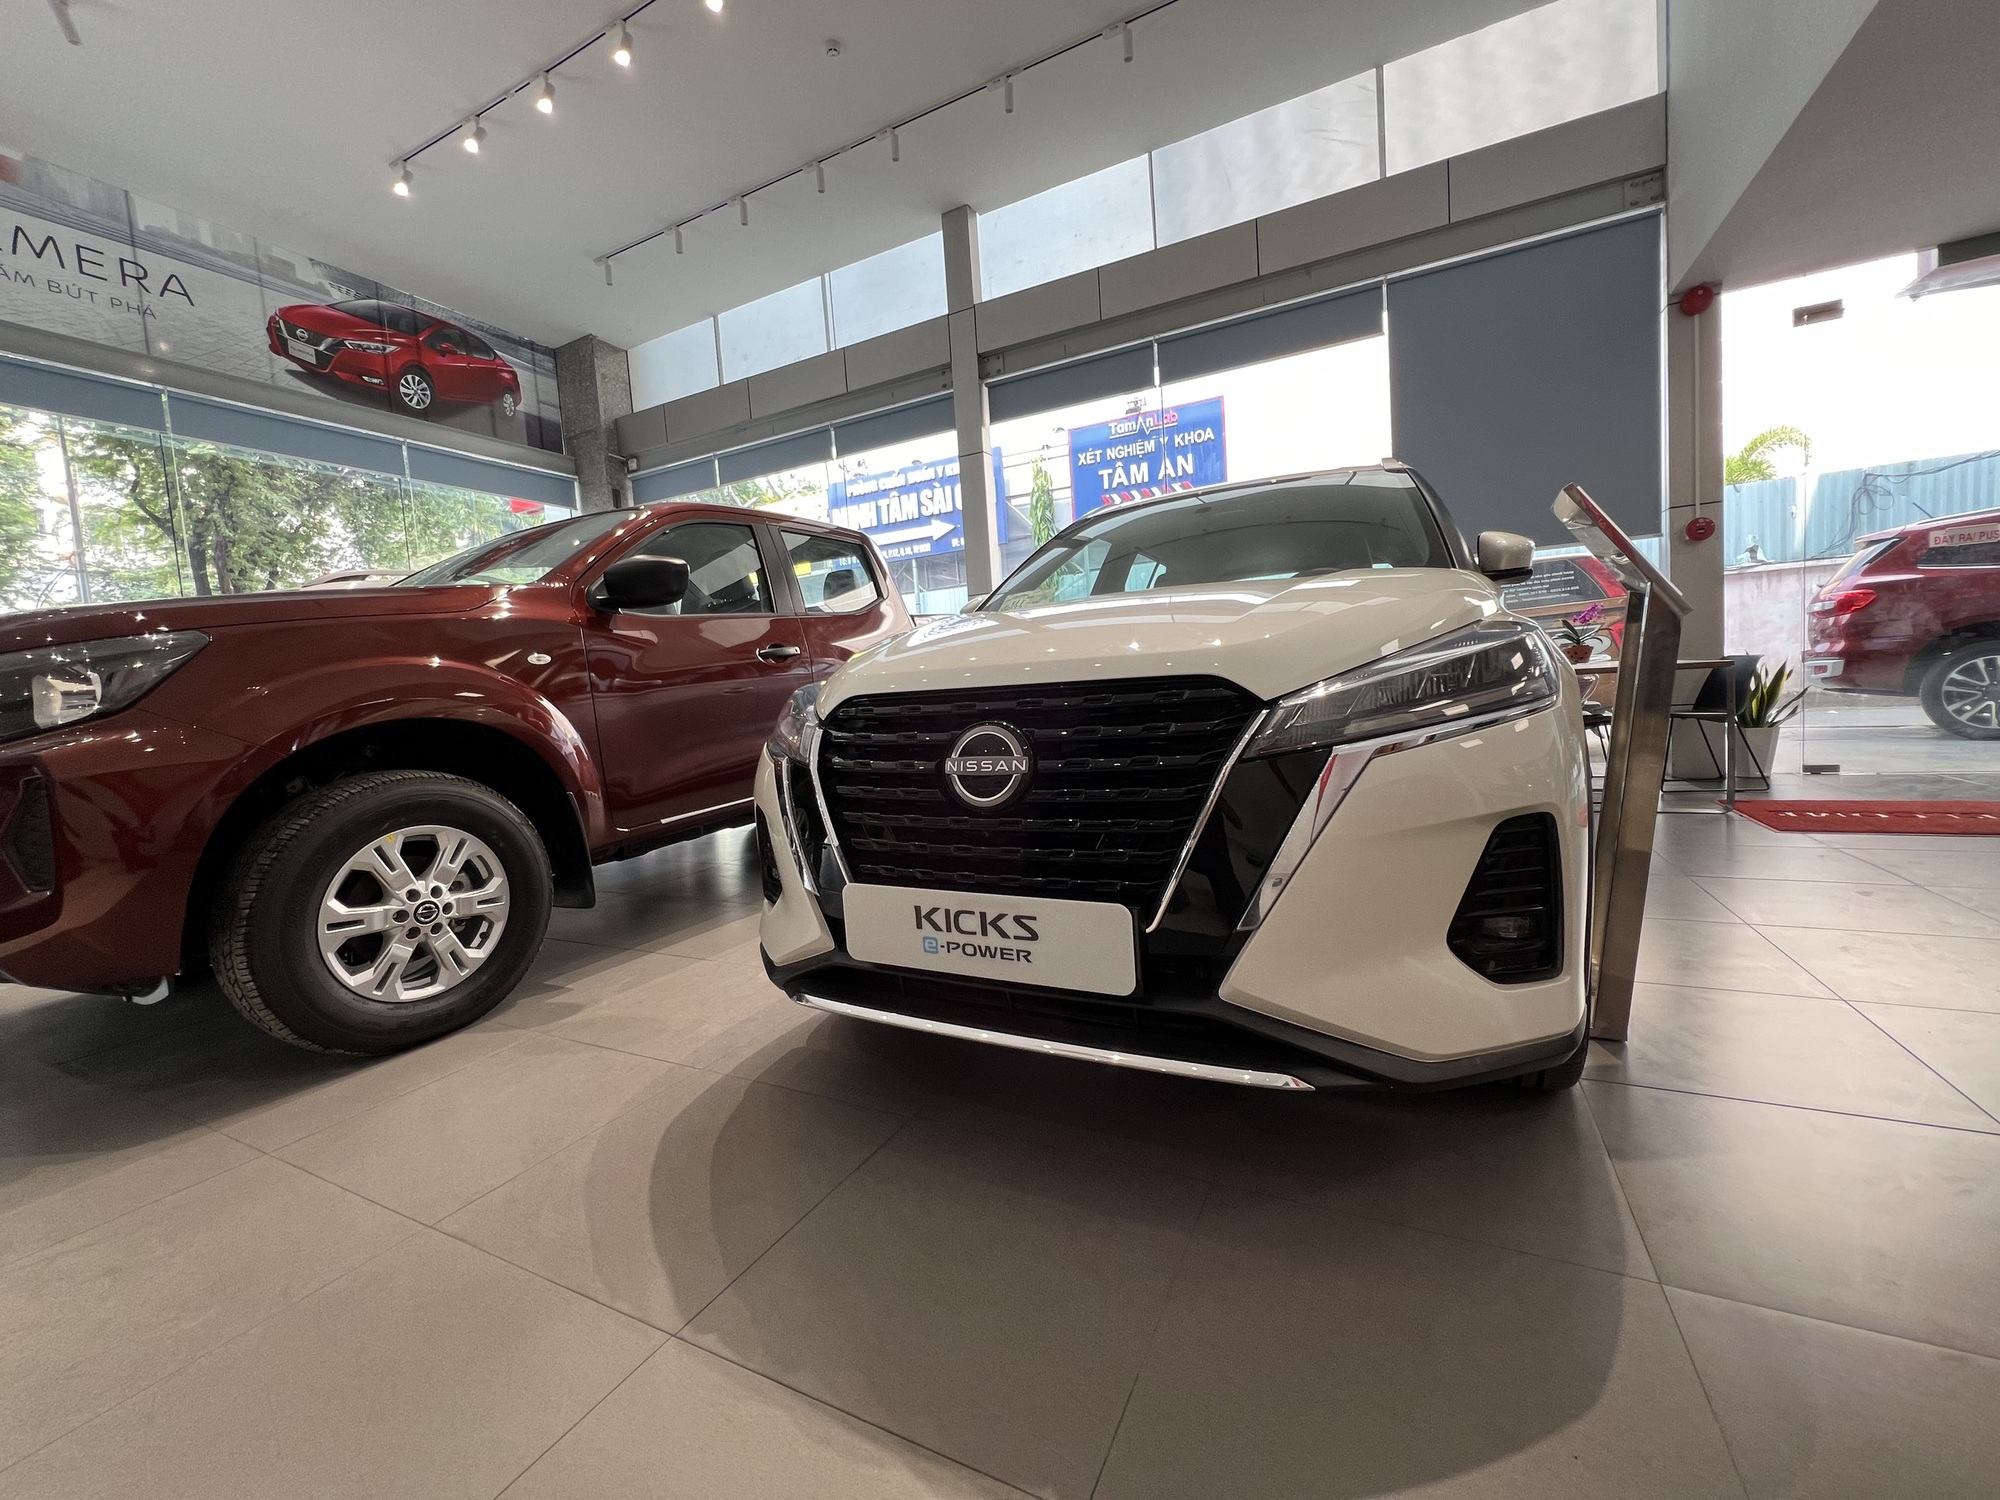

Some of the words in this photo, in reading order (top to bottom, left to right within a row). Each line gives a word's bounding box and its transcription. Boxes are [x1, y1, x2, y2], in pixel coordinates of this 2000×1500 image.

[0, 224, 195, 307] MERA
[110, 297, 157, 320] PHÁ
[1078, 448, 1102, 466] XÉT
[1106, 439, 1155, 458] NGHIỆM
[1174, 428, 1215, 447] KHOA
[1098, 462, 1149, 490] TÂM
[1157, 453, 1194, 480] AN
[877, 491, 919, 525] TÂM
[919, 482, 954, 516] SÀI
[1979, 529, 2000, 540] PUS
[947, 759, 1026, 772] NISSAN
[914, 905, 1040, 942] KICKS
[922, 936, 1033, 963] e-POWER
